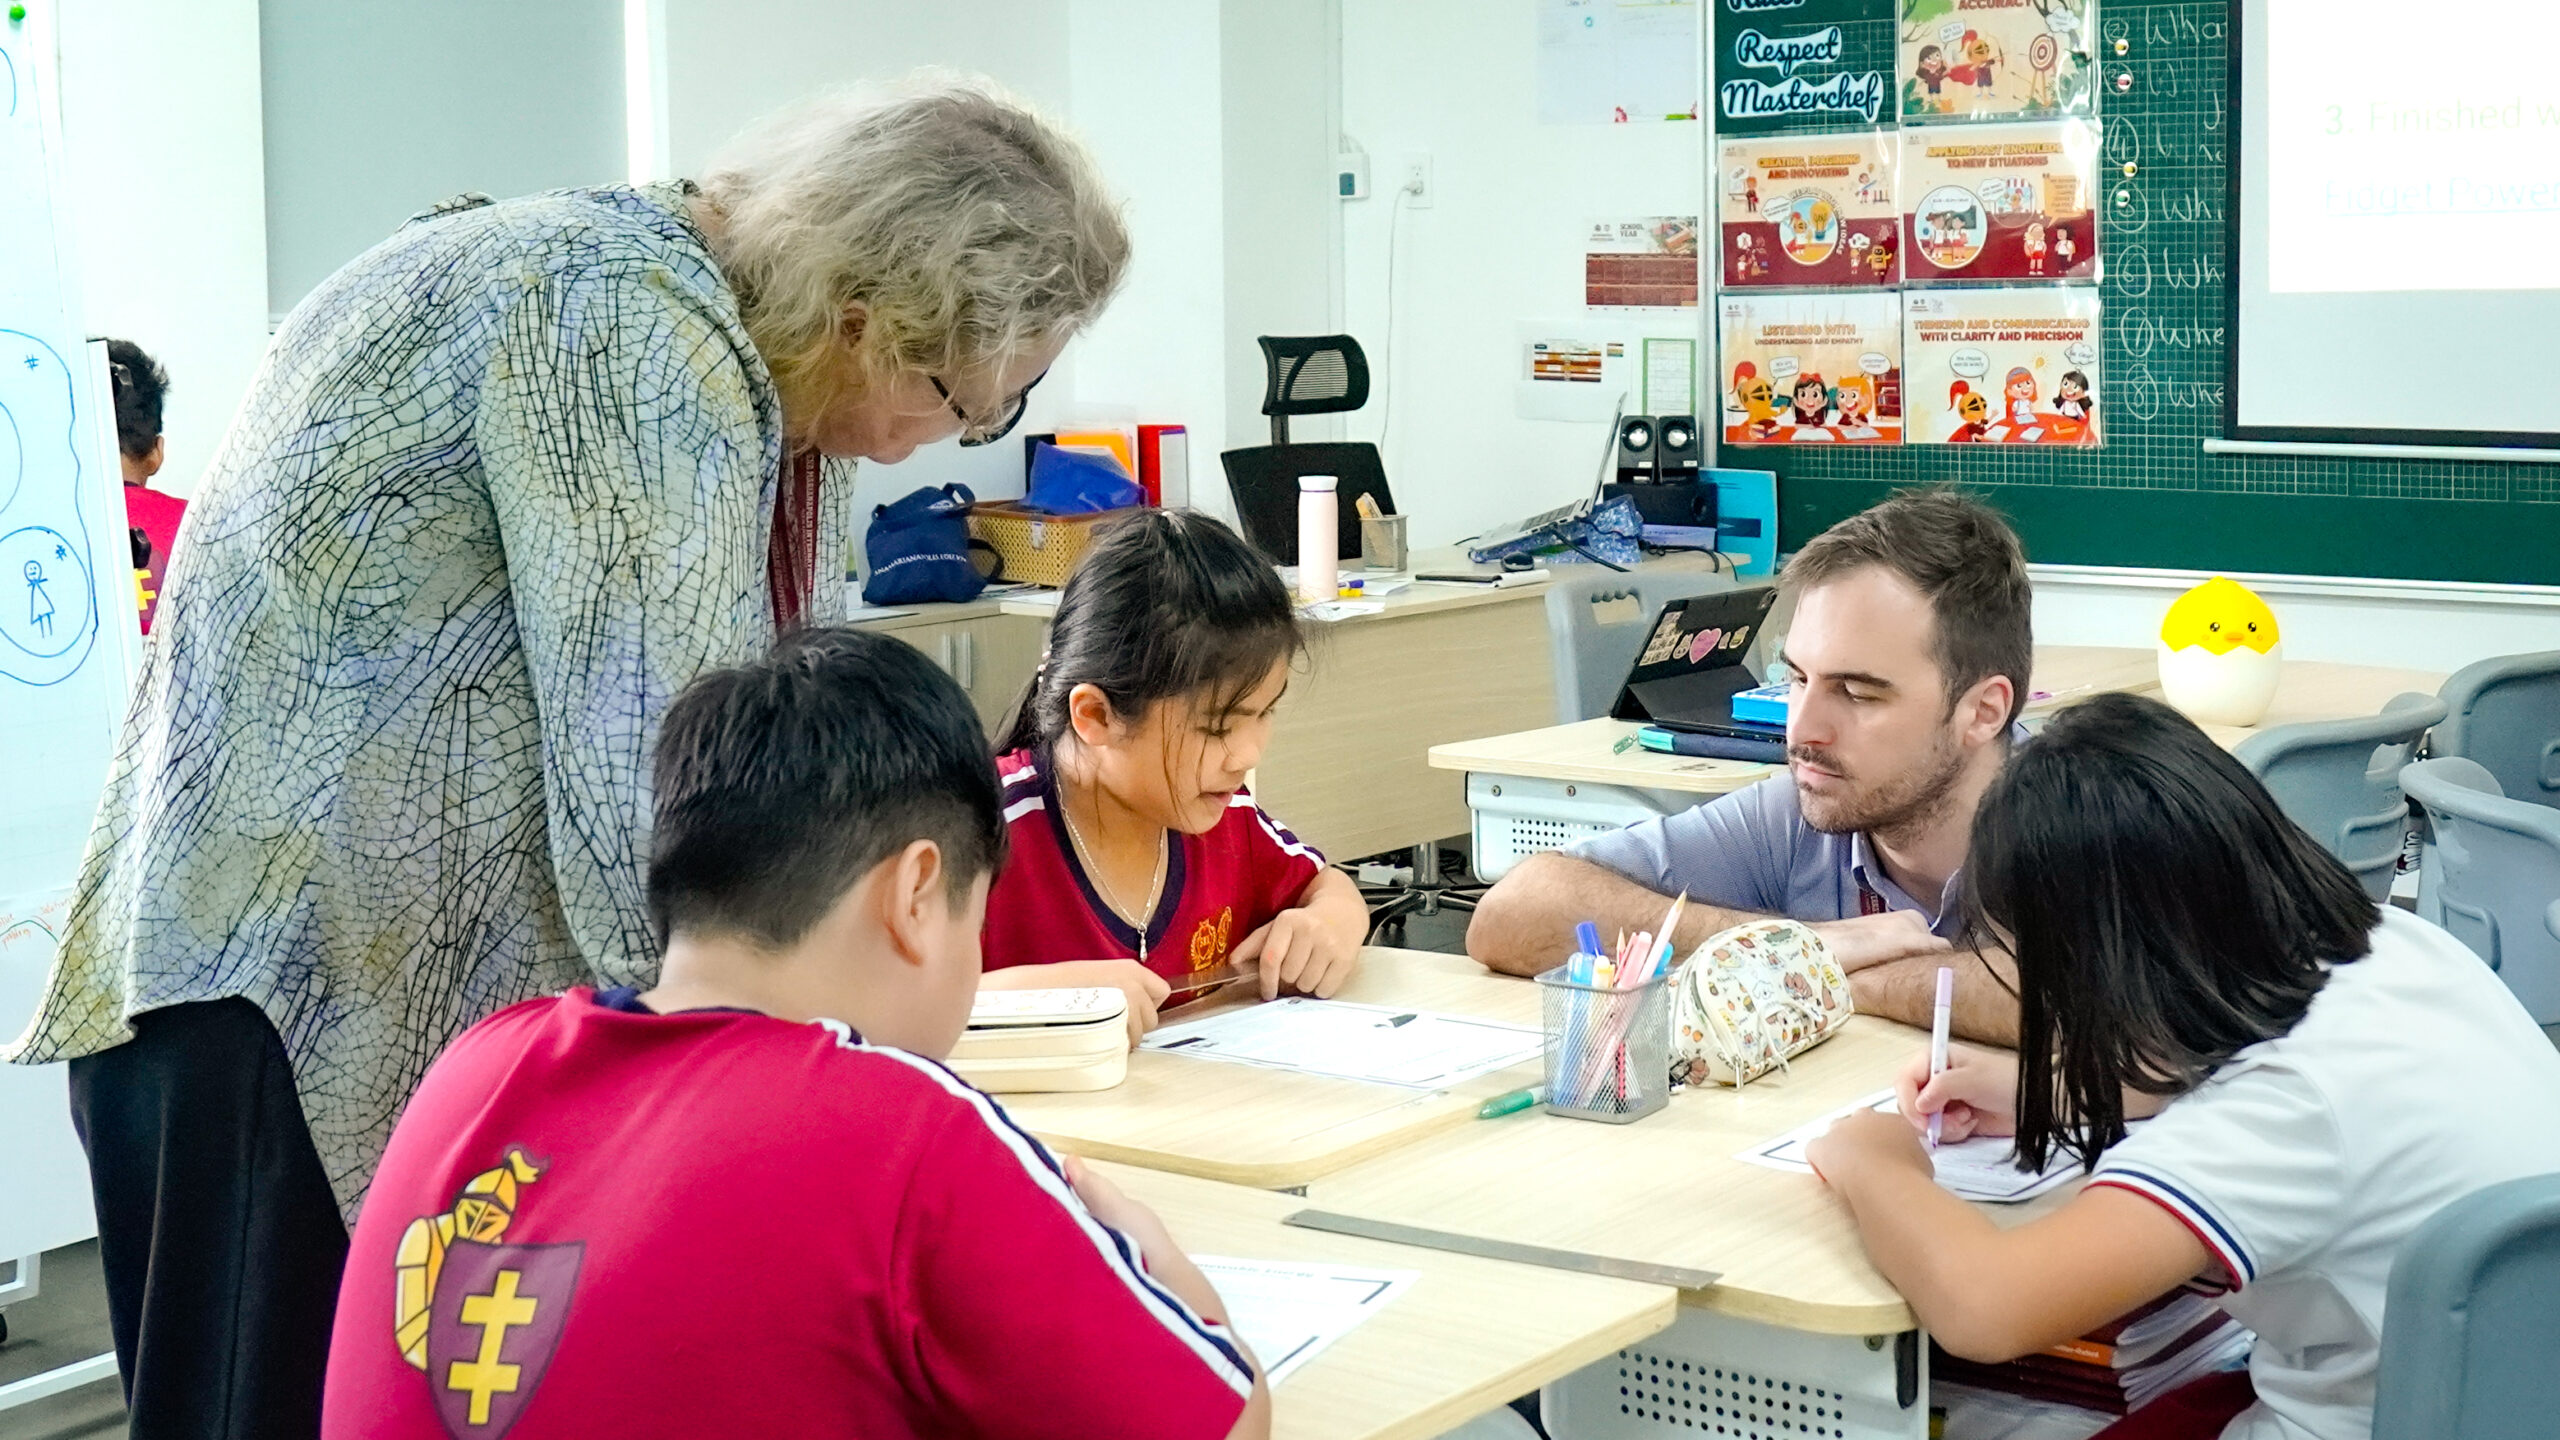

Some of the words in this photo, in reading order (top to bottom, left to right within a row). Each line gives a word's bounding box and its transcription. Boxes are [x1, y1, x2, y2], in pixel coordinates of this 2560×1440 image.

[2145, 3, 2227, 44] Wha
[1738, 27, 1839, 77] Respect
[1722, 73, 1879, 119] Masterchef
[2369, 96, 2522, 133] Finished
[1976, 144, 2003, 156] PAST
[1946, 158, 1961, 168] TO
[1962, 157, 1987, 168] NEW
[1989, 156, 2049, 167] SITUATIONS
[1768, 169, 1789, 180] AND
[1790, 167, 1850, 179] INNOVATING
[2163, 246, 2225, 289] Wh
[1762, 324, 1823, 336] LISTENING
[1824, 323, 1857, 335] WITH
[1914, 319, 1965, 330] THINKING
[1966, 319, 1991, 330] AND
[1992, 318, 2091, 330] COMMUNICATING
[1754, 337, 1813, 346] UNDERSTANDING
[1814, 337, 1830, 345] AND
[1831, 337, 1864, 345] EMPATHY
[1920, 331, 1949, 342] WITH
[1951, 331, 1996, 342] CLARITY
[1997, 331, 2022, 342] AND
[2024, 330, 2084, 342] PRECISION
